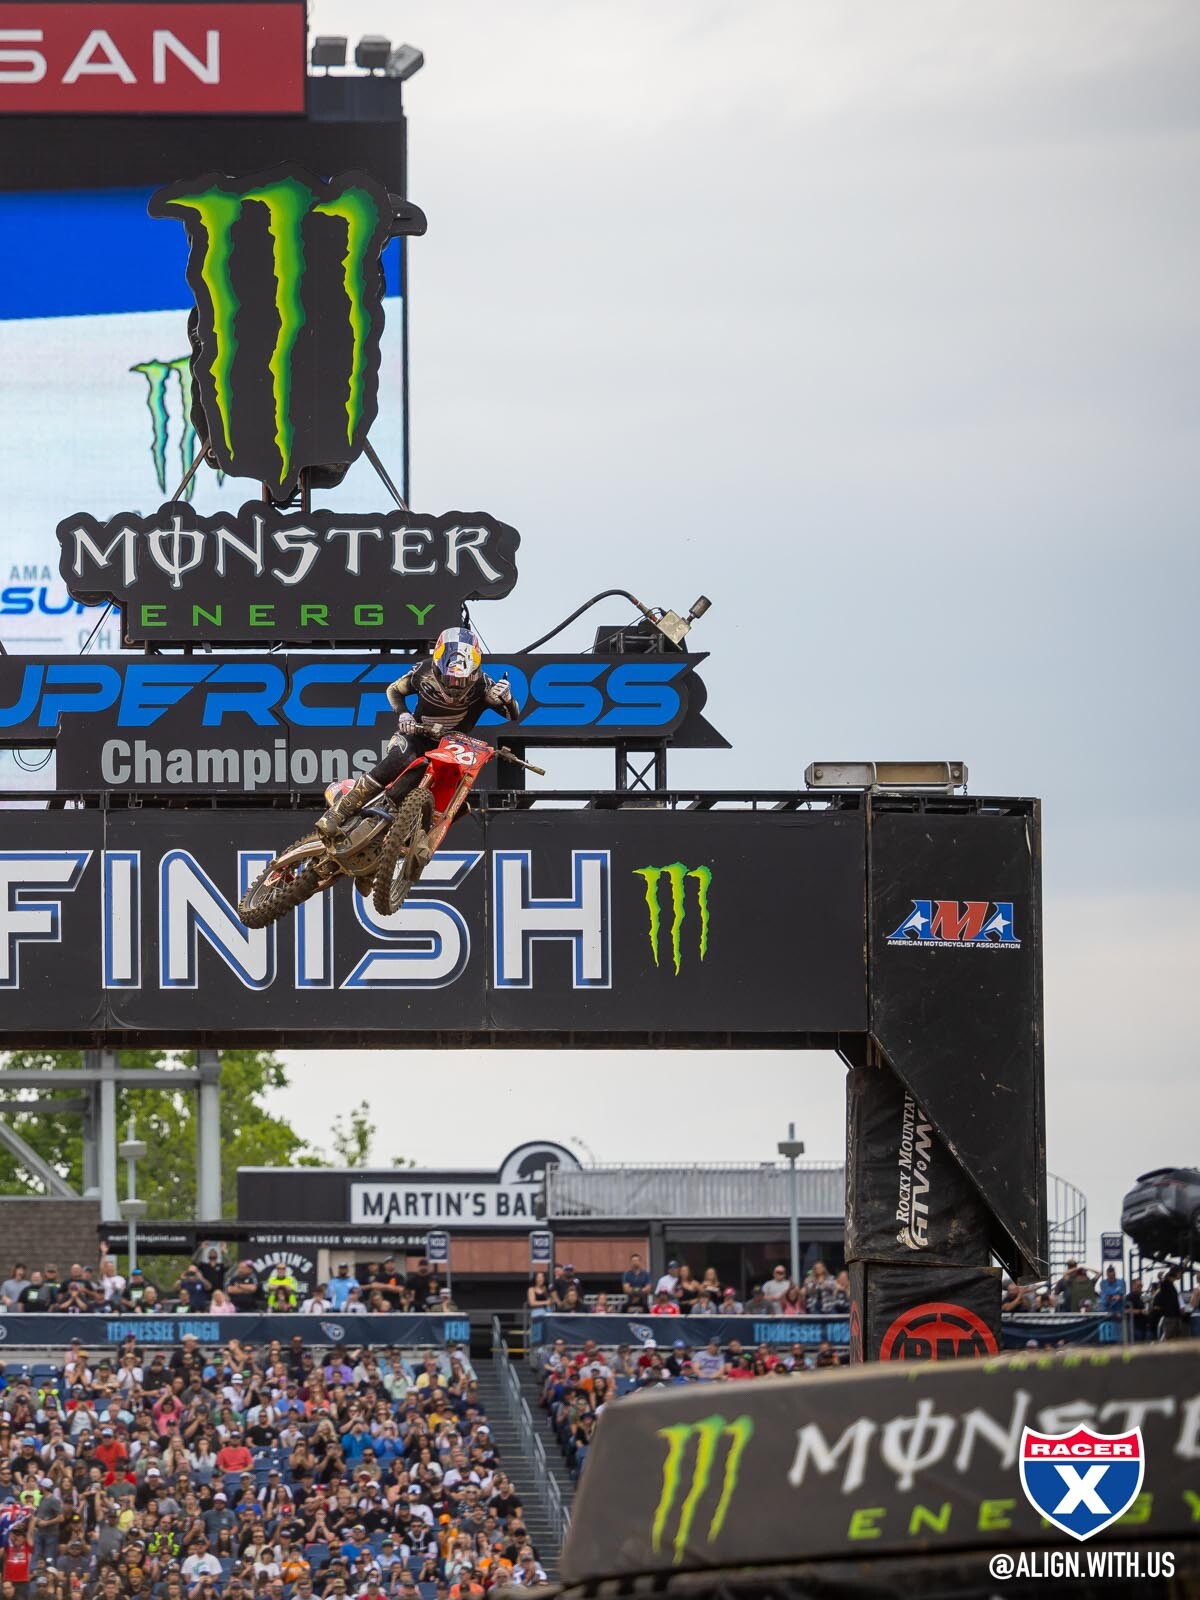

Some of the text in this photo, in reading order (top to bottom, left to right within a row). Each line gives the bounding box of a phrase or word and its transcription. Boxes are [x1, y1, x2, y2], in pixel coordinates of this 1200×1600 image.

[72, 514, 502, 590] MONSTER
[9, 564, 52, 581] AMA
[141, 603, 436, 628] ENERGY
[101, 738, 392, 791] Champions
[885, 899, 1022, 943] AMA
[887, 939, 1021, 950] AMERICAN MOTORCYCLIST ASSOCIATION
[896, 1090, 915, 1224] ROCKY MOUNTAI
[362, 1191, 486, 1217] MARTIN'S
[256, 1235, 283, 1243] WEST
[253, 1252, 313, 1274] MARTIN'S
